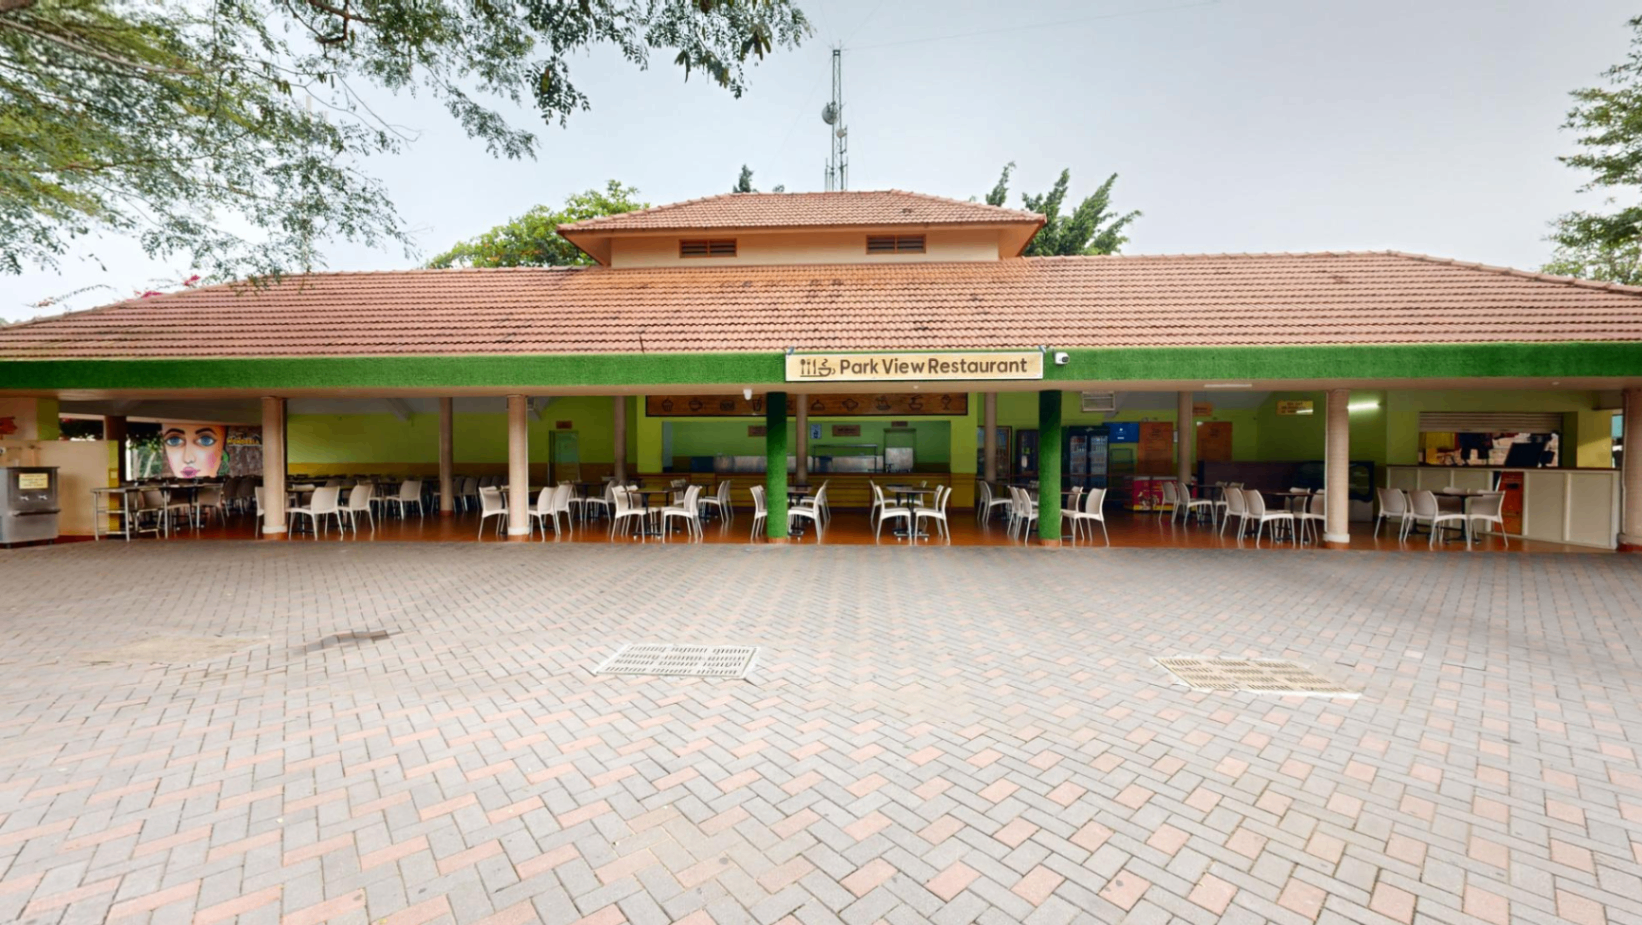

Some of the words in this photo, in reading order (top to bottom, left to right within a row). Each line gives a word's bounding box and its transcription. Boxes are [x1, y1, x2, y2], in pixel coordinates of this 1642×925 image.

[840, 359, 878, 374] Park
[882, 358, 925, 373] View
[928, 358, 1028, 373] Restaurant
